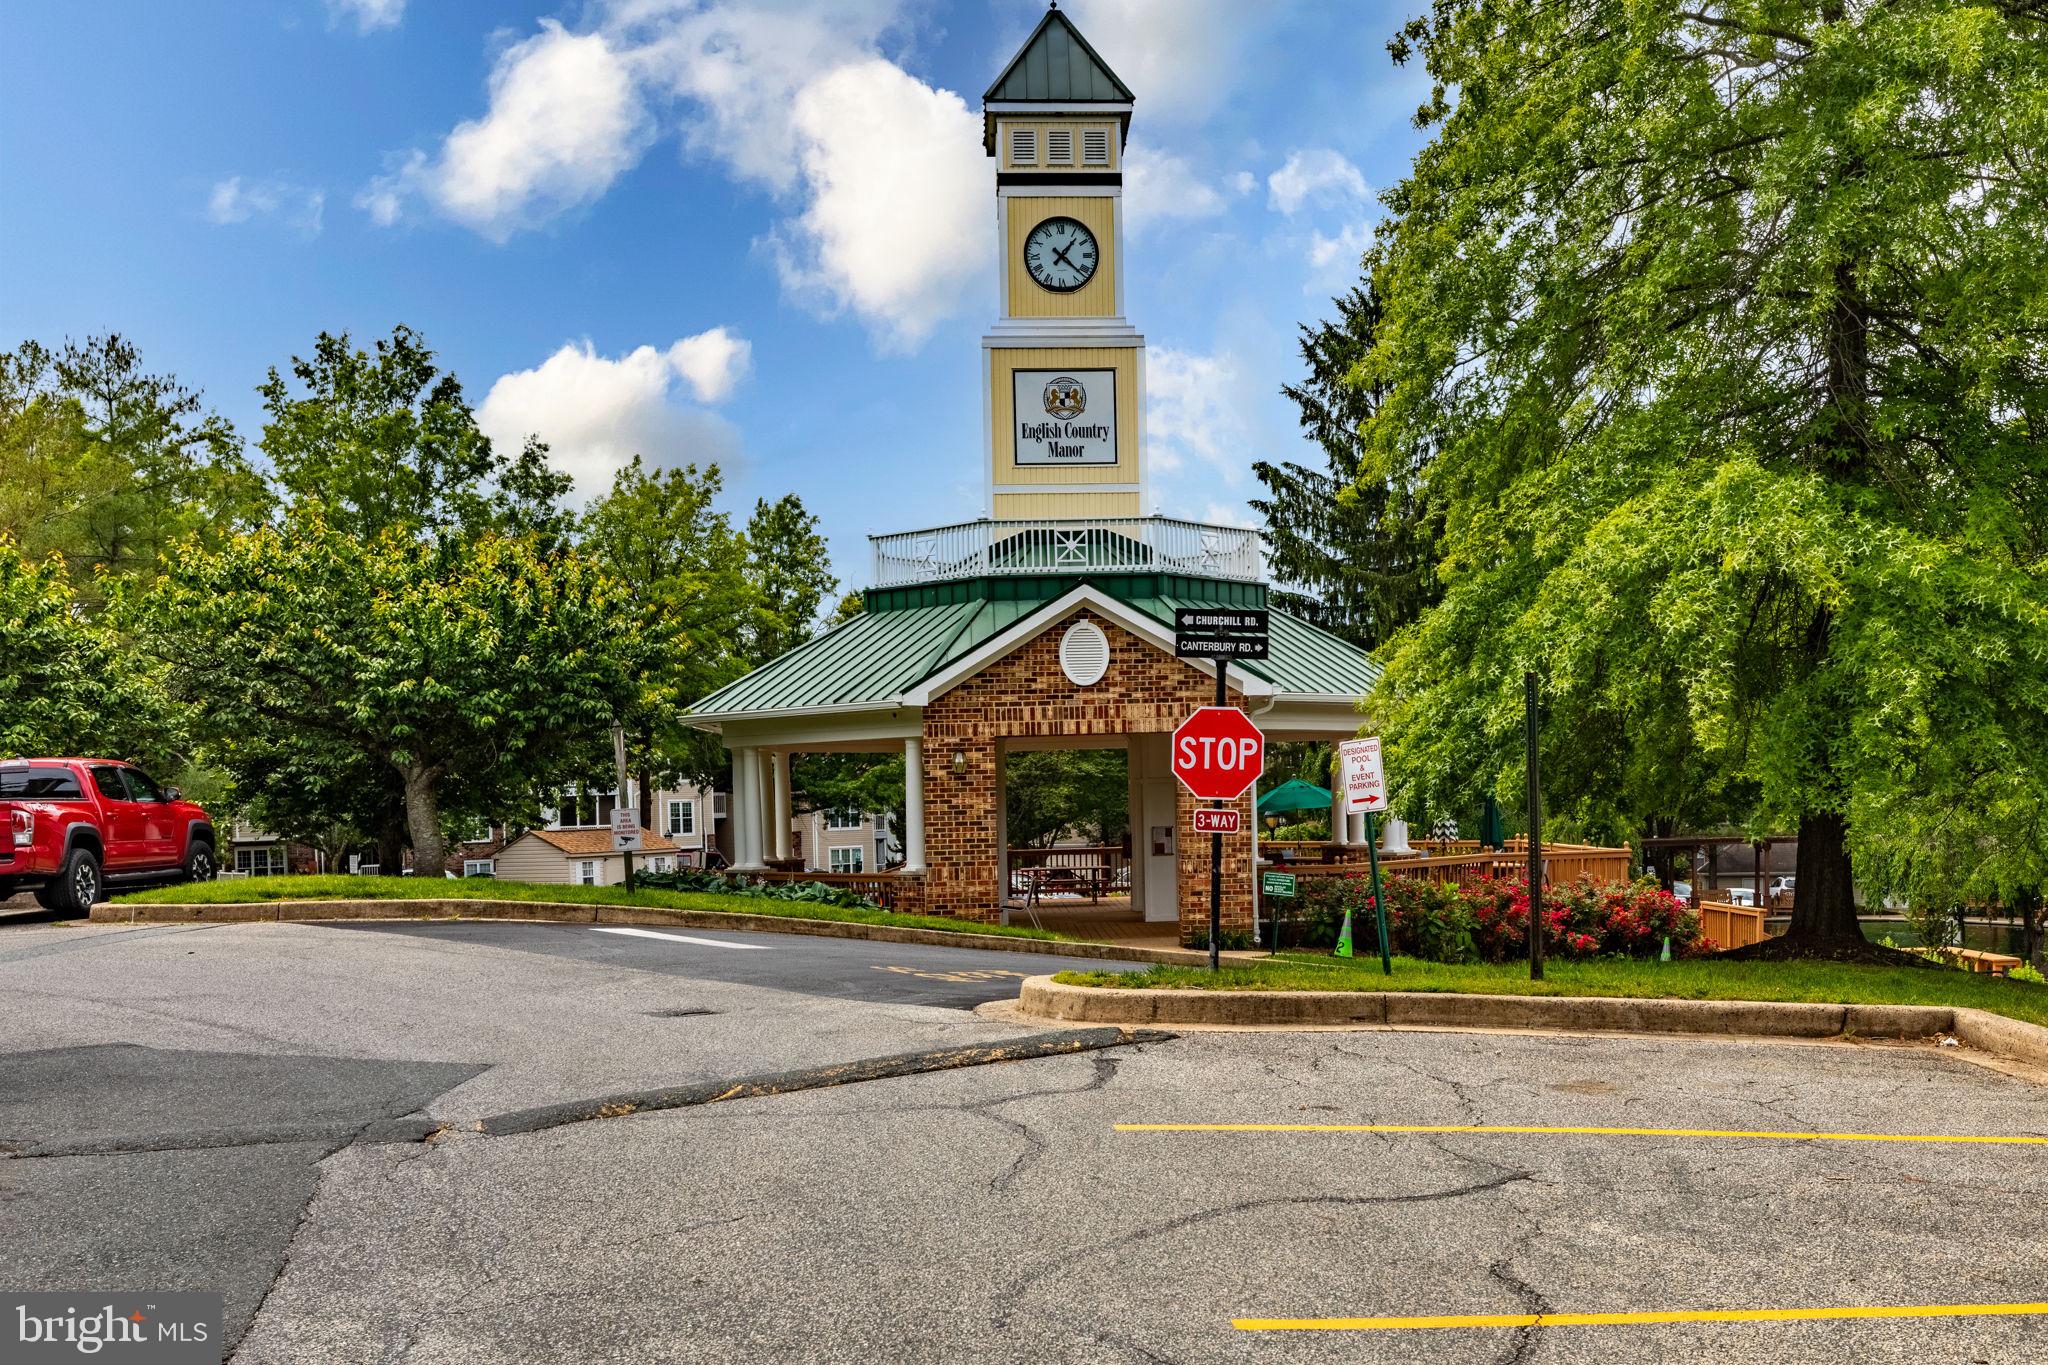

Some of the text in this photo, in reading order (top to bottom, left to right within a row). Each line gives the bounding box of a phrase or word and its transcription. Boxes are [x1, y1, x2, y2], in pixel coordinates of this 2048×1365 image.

[1021, 421, 1110, 443] English Country
[1047, 441, 1085, 458] Manor
[1195, 615, 1259, 626] CHURCHILL RD.
[1180, 640, 1253, 653] CANTERBURY RD.
[1178, 736, 1258, 771] STOP
[1343, 744, 1378, 757] DESIGNATED
[1351, 754, 1372, 764] POOL
[1359, 764, 1365, 772] &
[1351, 771, 1375, 782] EVENT
[1348, 780, 1380, 791] PARKING
[1197, 813, 1236, 829] 3-WAY
[1336, 941, 1345, 953] 2
